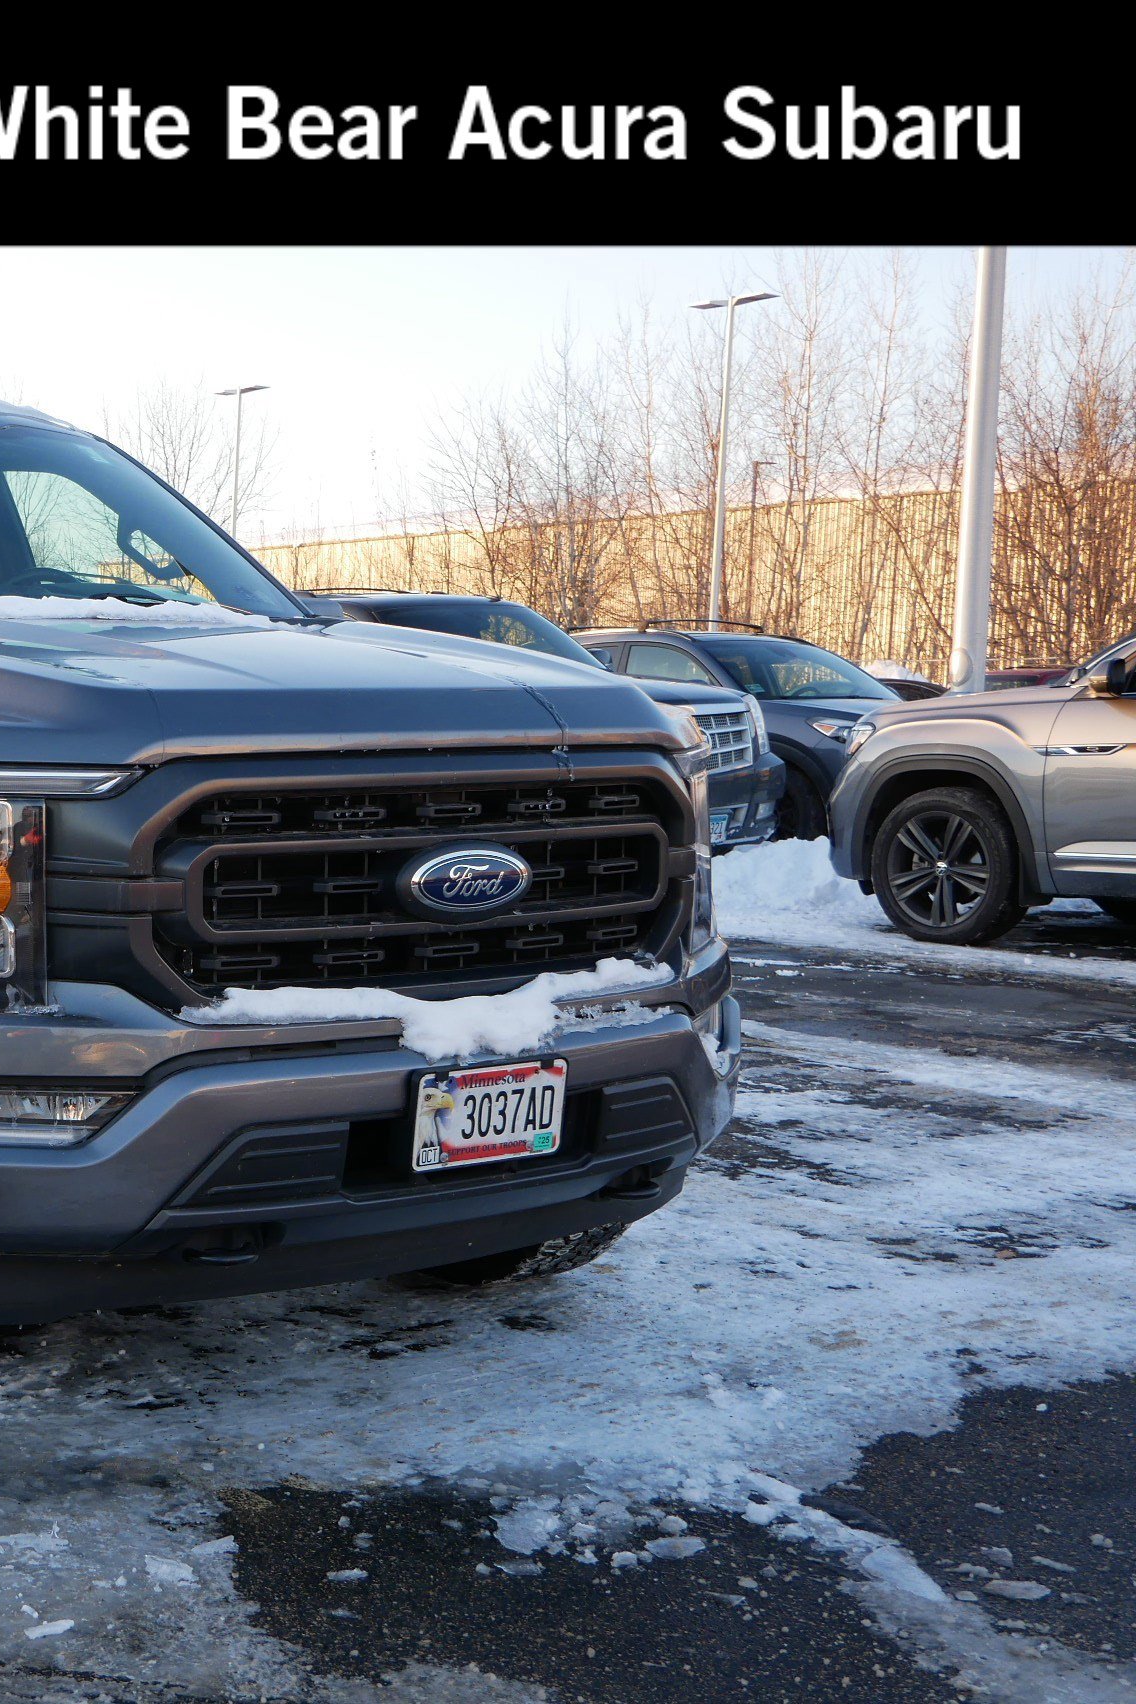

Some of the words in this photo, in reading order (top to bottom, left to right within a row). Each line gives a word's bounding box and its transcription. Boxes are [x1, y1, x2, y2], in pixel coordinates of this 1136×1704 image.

[442, 864, 504, 898] Ford
[460, 1072, 526, 1090] Minnesota
[461, 1084, 555, 1140] 3037AD
[482, 1143, 497, 1152] OUR
[499, 1139, 527, 1150] TROOPS
[421, 1149, 438, 1164] OCT
